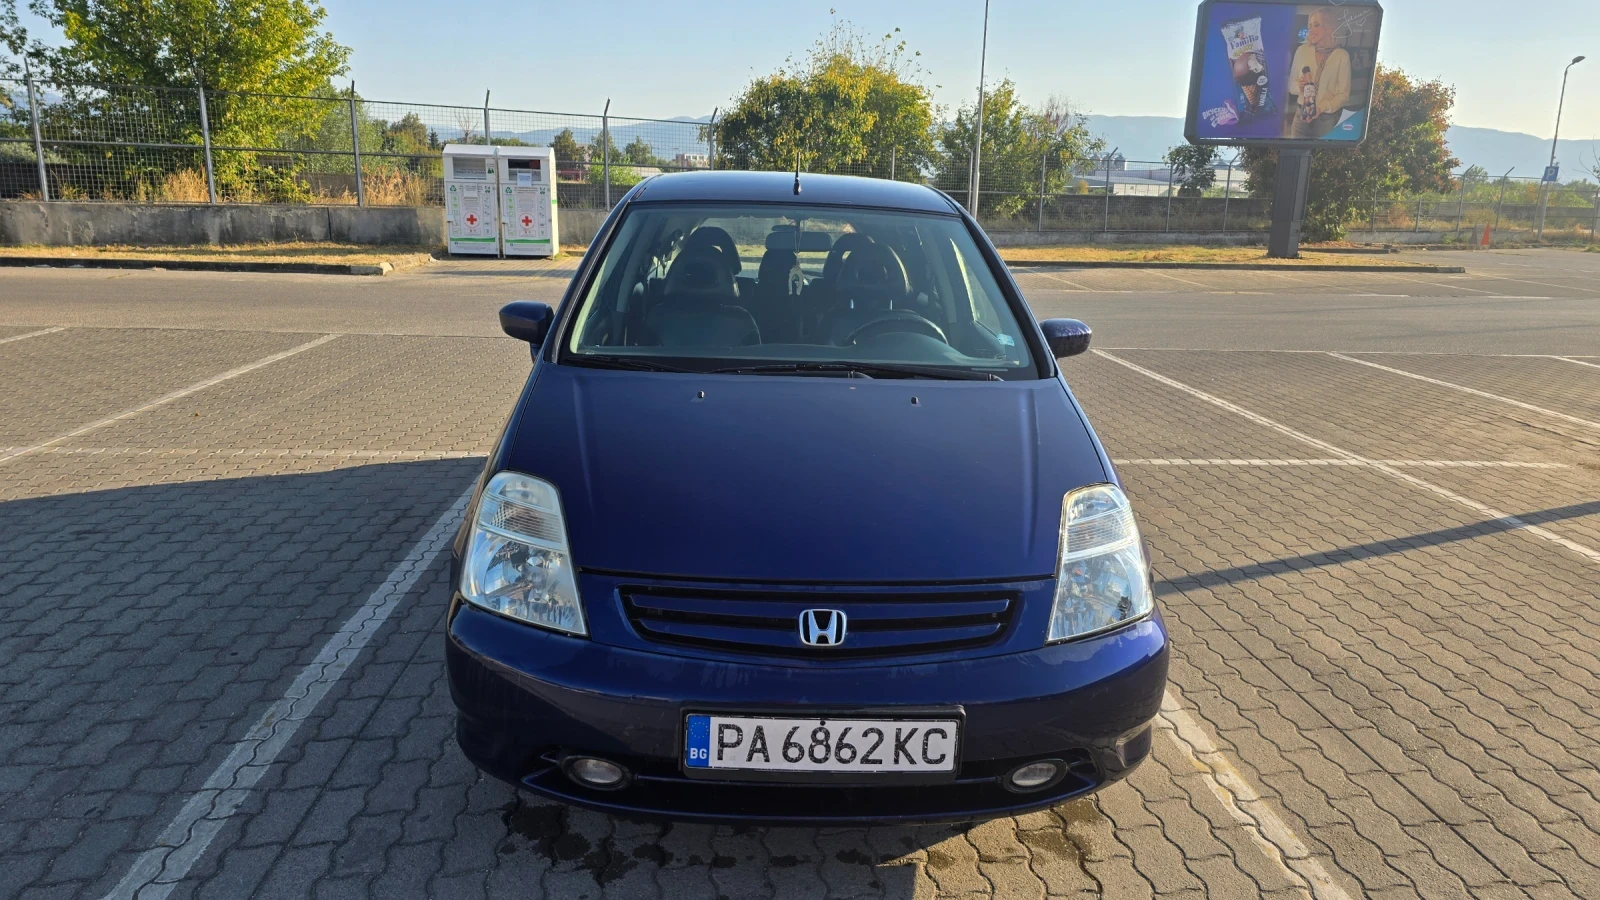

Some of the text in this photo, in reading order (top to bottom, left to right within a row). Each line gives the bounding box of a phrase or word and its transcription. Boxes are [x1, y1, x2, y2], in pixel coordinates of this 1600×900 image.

[1546, 168, 1556, 180] P
[781, 725, 885, 766] 6862
[689, 747, 708, 760] BG
